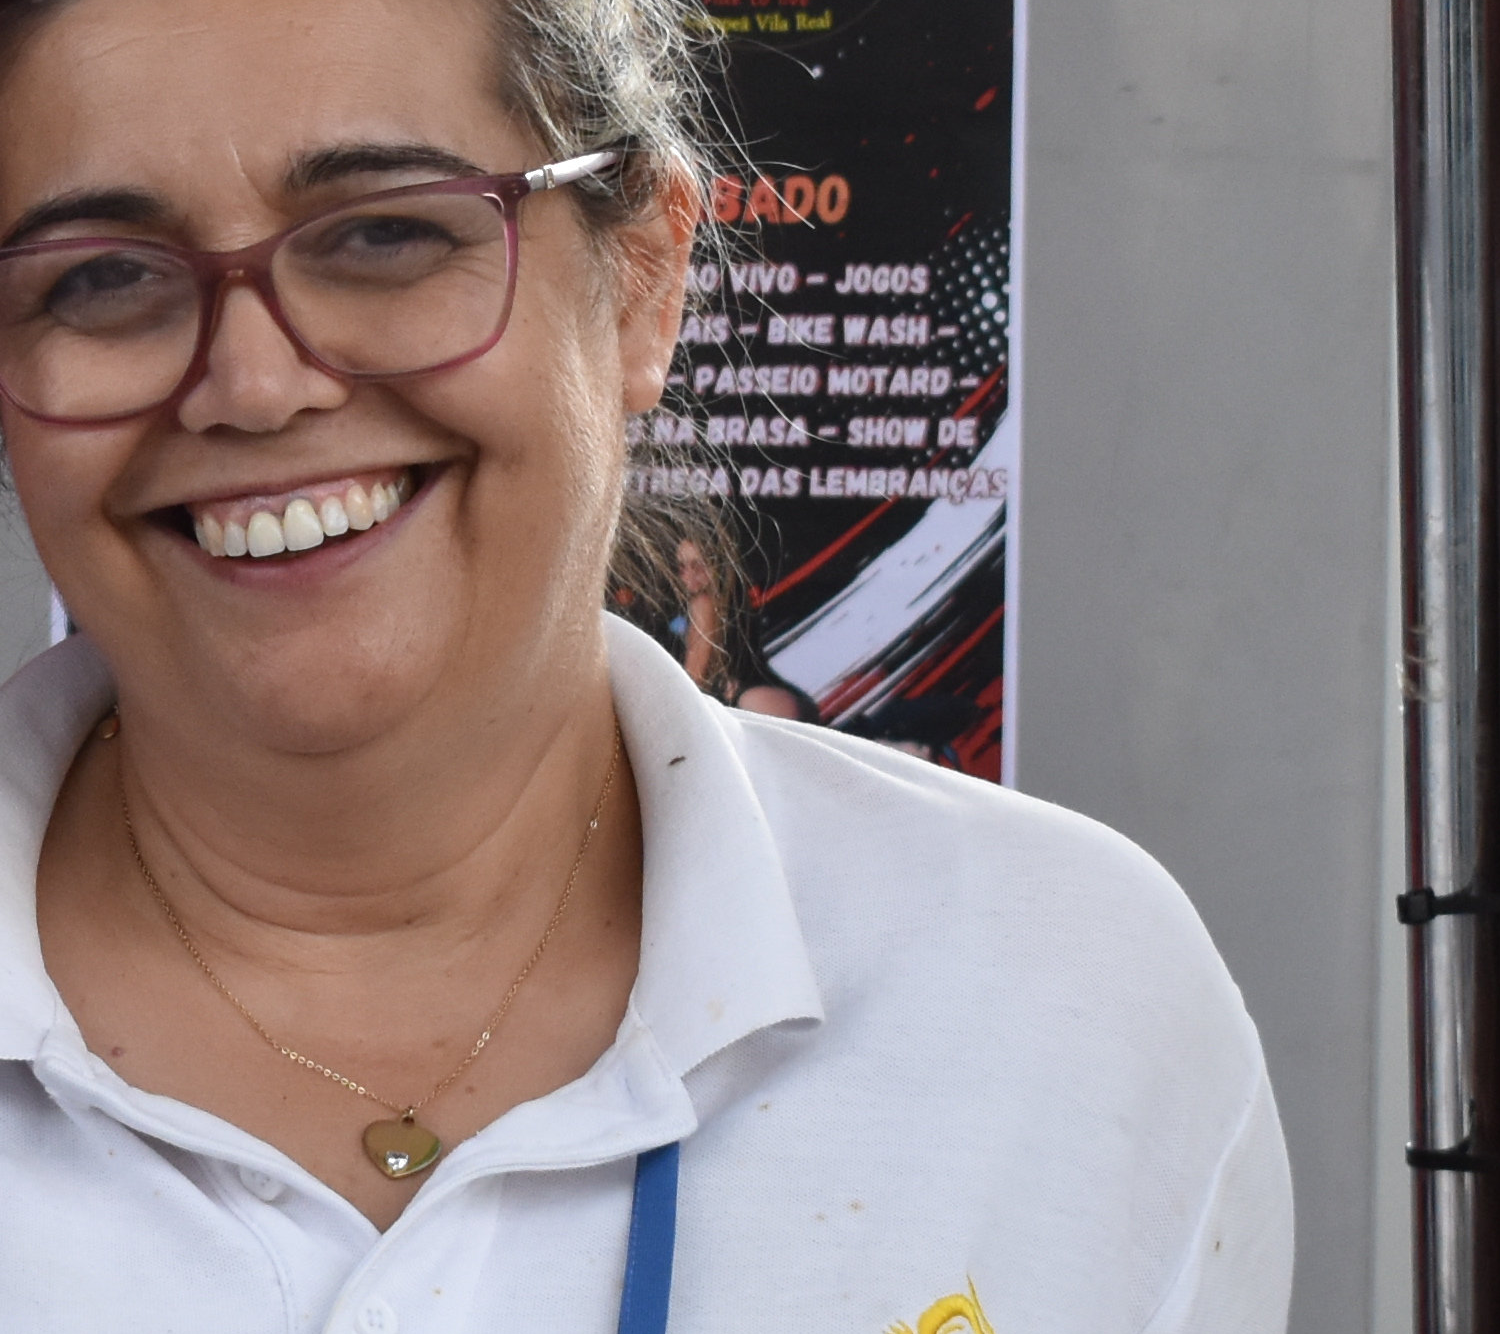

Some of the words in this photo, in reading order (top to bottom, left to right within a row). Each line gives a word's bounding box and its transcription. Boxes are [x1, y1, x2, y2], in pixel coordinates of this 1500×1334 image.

[756, 10, 788, 32] Vila
[796, 9, 831, 30] Real
[730, 264, 797, 294] VIVO
[834, 263, 930, 294] JOGOS
[768, 315, 833, 345] BIKE
[843, 314, 931, 345] WASH
[694, 364, 820, 396] PASSEIO
[828, 365, 952, 397] MOTARD
[654, 417, 698, 445] NA
[707, 416, 810, 447] BRASA
[847, 416, 929, 447] SHOW
[938, 417, 979, 447] DE
[740, 467, 800, 498] DAS
[809, 467, 1008, 504] LEMBRANÇAS
